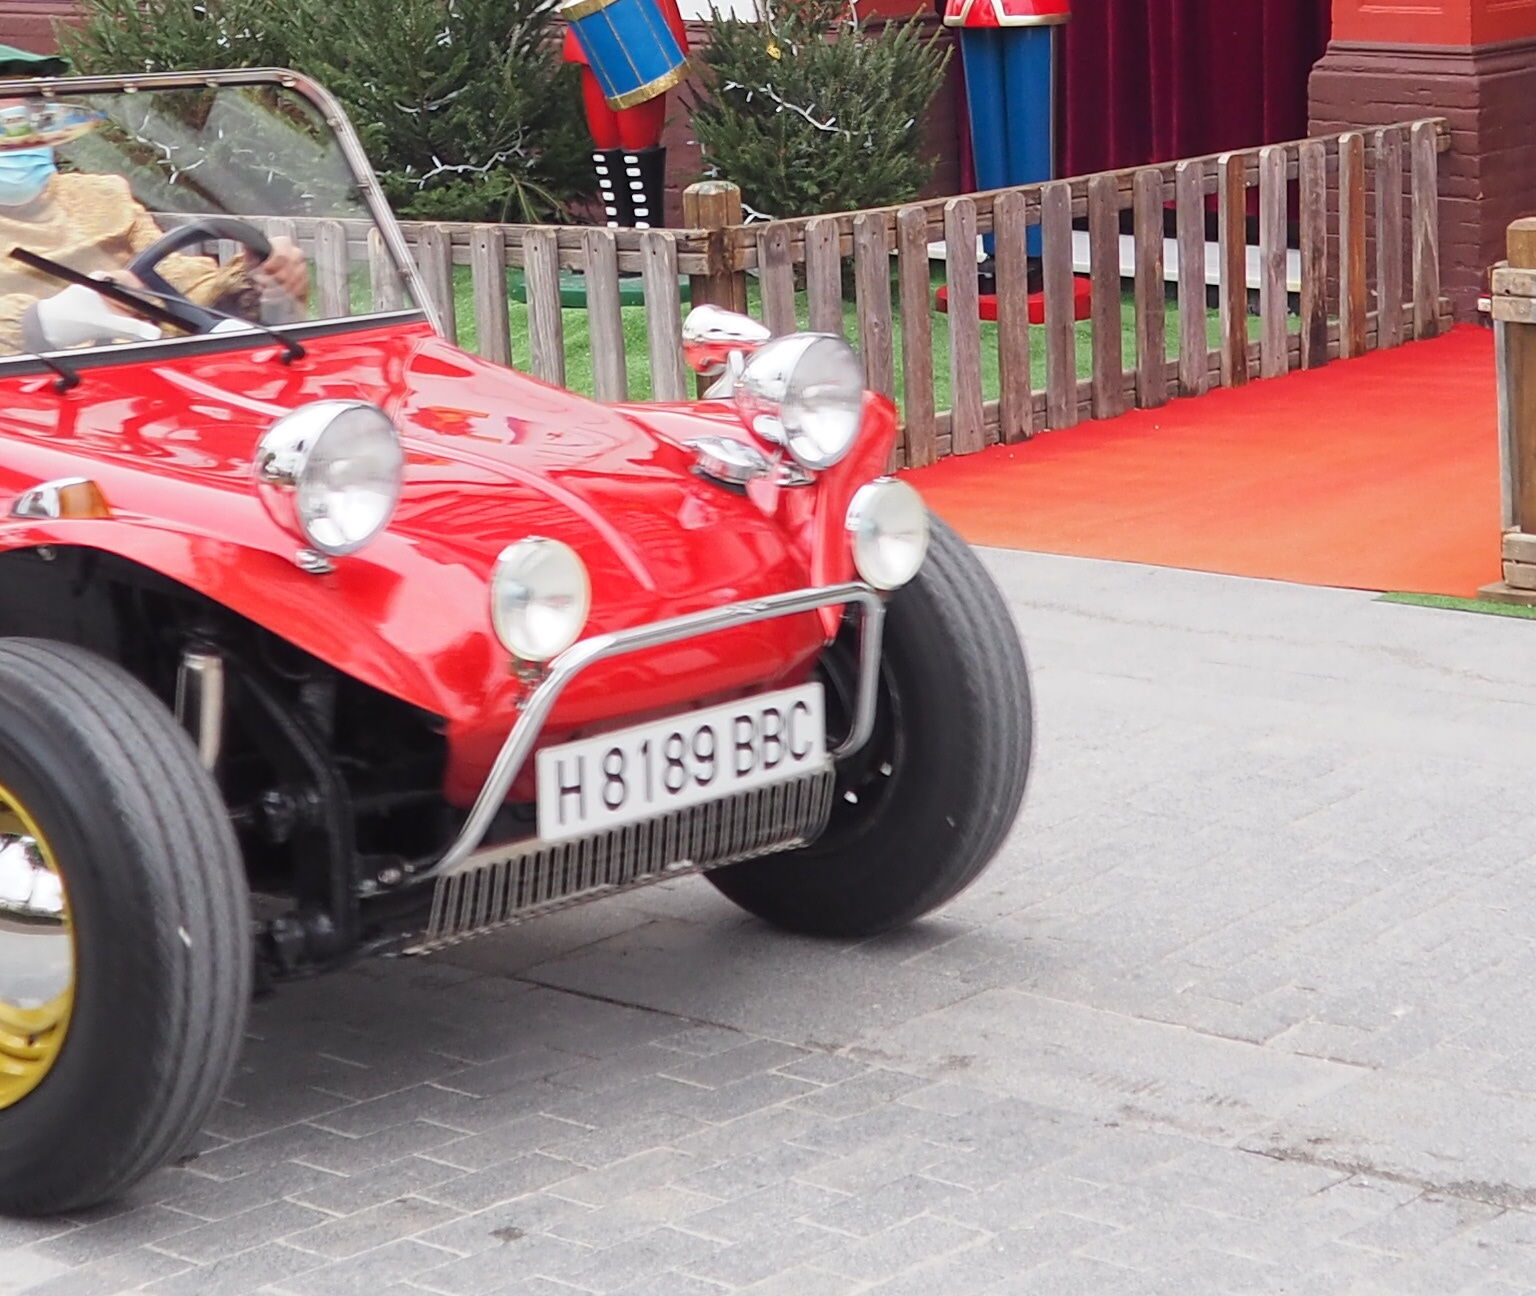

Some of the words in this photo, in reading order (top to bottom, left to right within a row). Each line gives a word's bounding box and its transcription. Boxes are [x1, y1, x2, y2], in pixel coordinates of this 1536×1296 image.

[557, 755, 586, 825] H
[602, 724, 717, 811] 8189
[733, 700, 814, 777] BBC
